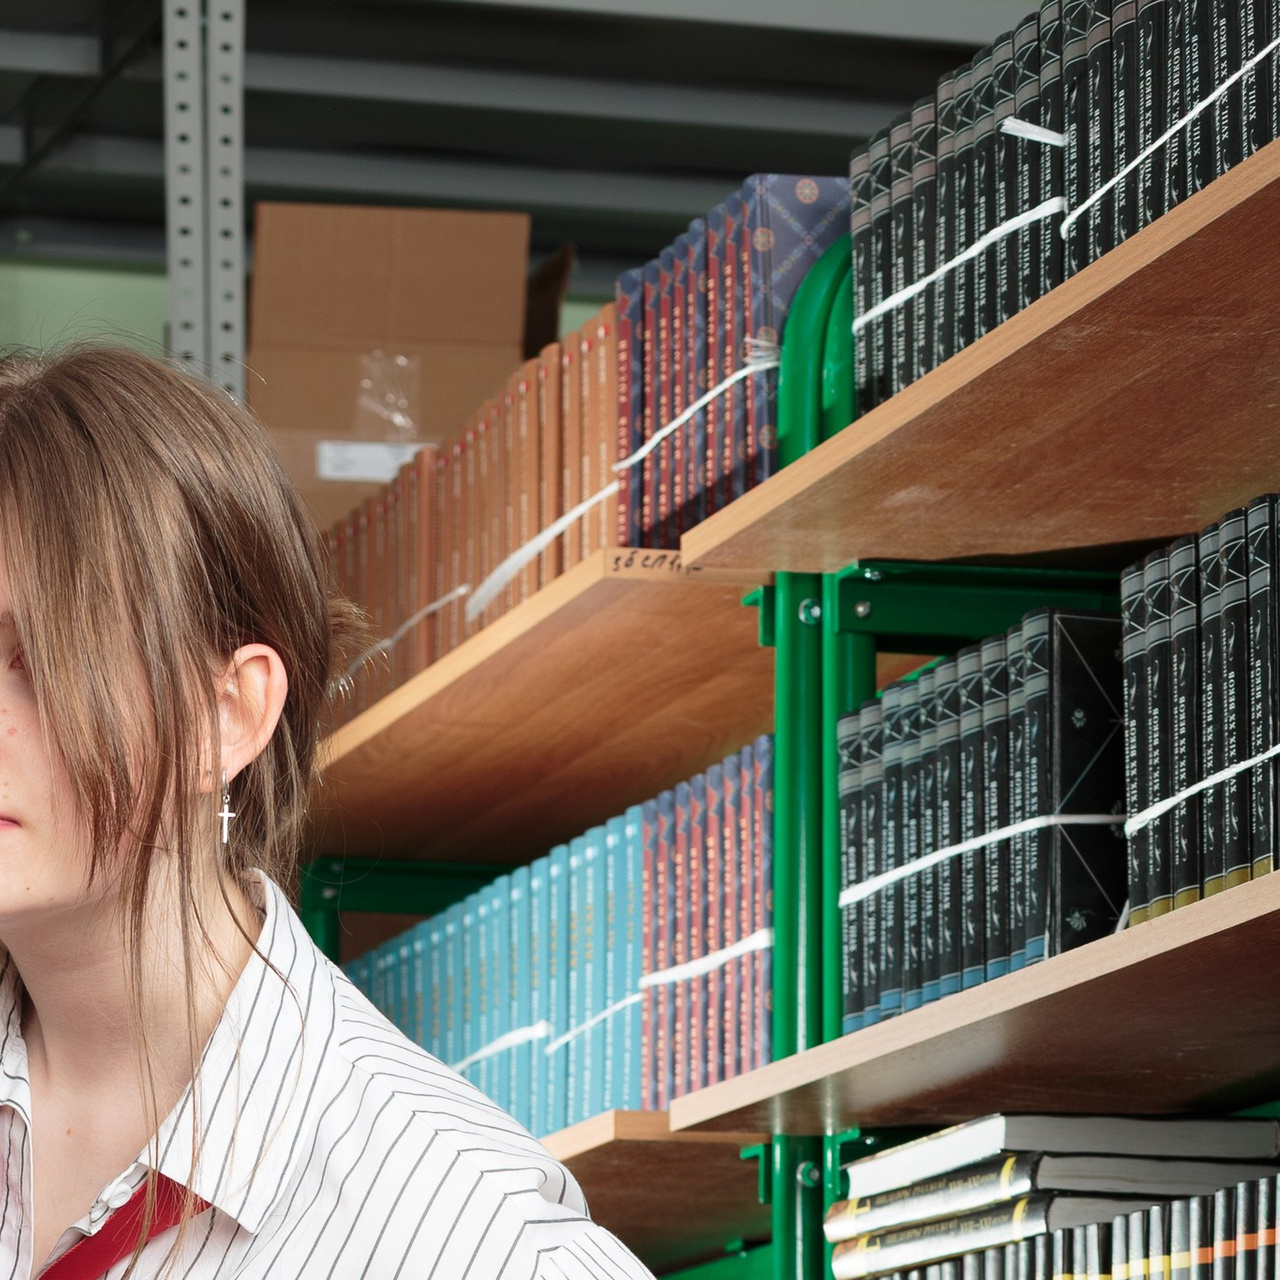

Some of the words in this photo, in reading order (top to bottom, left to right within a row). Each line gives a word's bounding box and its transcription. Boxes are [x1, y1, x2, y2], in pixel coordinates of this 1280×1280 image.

[1219, 17, 1227, 57] ВЕКОВ
[1172, 47, 1180, 86] ВЕКОВ
[1248, 86, 1257, 120] XVIII,
[1069, 122, 1077, 159] ВЕКОВ
[1221, 106, 1229, 141] XVIII,
[1228, 671, 1236, 710] ВЕКОВ
[1254, 659, 1262, 699] ВЕКОВ
[1205, 682, 1213, 721] ВЕКОВ
[1129, 719, 1137, 757] ВЕКОВ
[1152, 707, 1160, 745] ВЕКОВ
